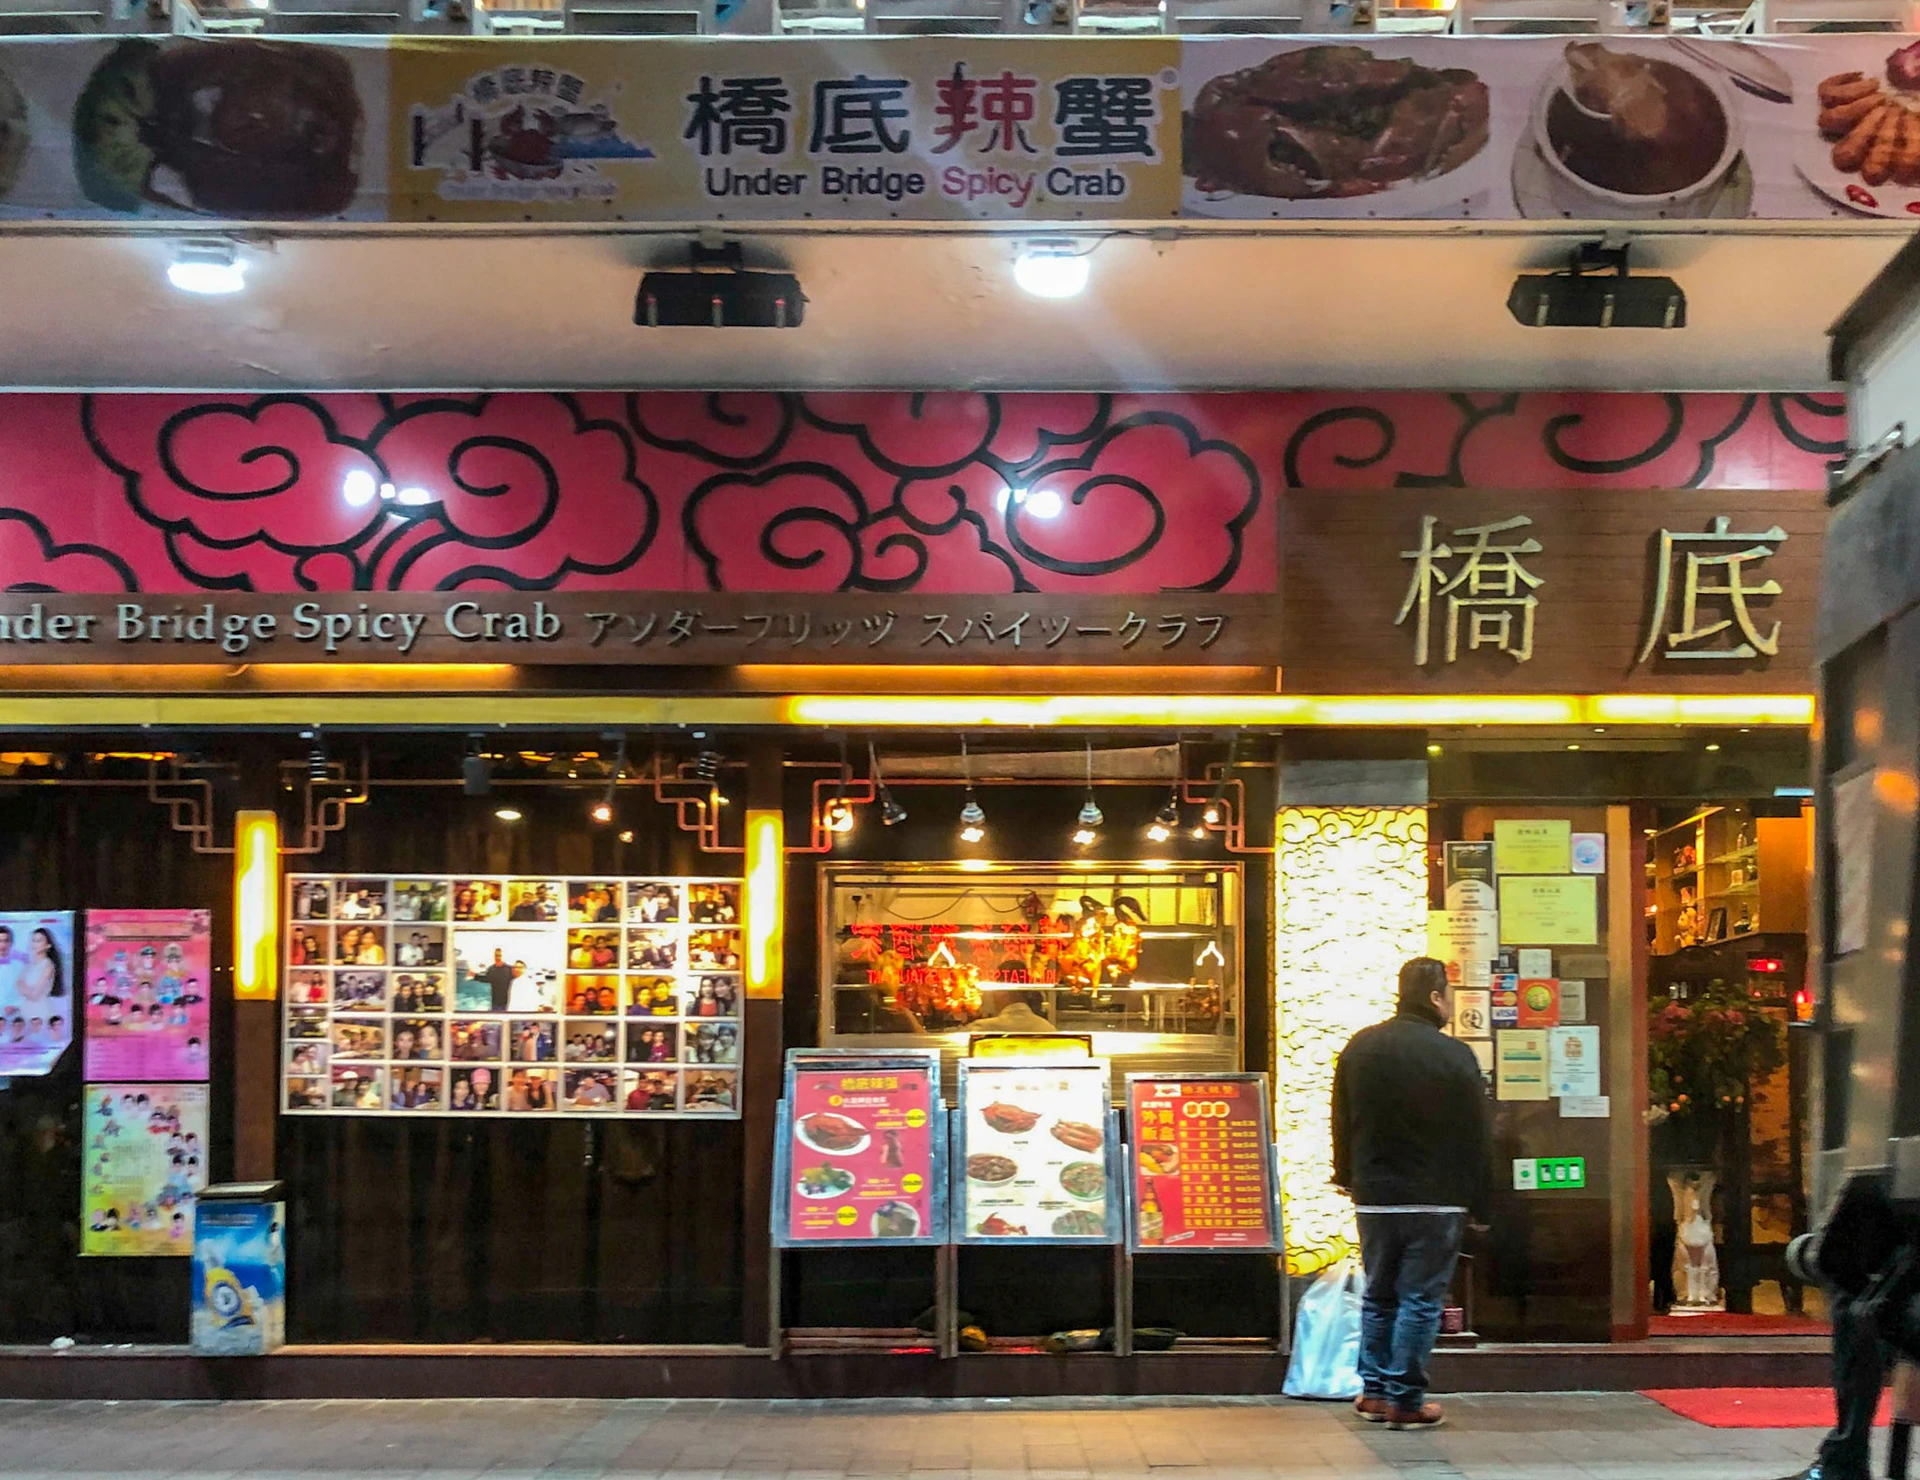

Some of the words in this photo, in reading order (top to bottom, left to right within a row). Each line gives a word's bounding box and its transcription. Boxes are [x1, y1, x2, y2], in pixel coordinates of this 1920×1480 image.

[685, 62, 1155, 156] 橋底辣蟹
[706, 167, 807, 196] Under
[821, 167, 925, 203] Bridge
[942, 166, 1034, 208] Spicy
[1047, 167, 1125, 196] Crab
[1393, 515, 1788, 665] 橋底
[117, 603, 277, 653] Bridge
[293, 602, 426, 652] Spicy
[445, 602, 560, 640] Crab
